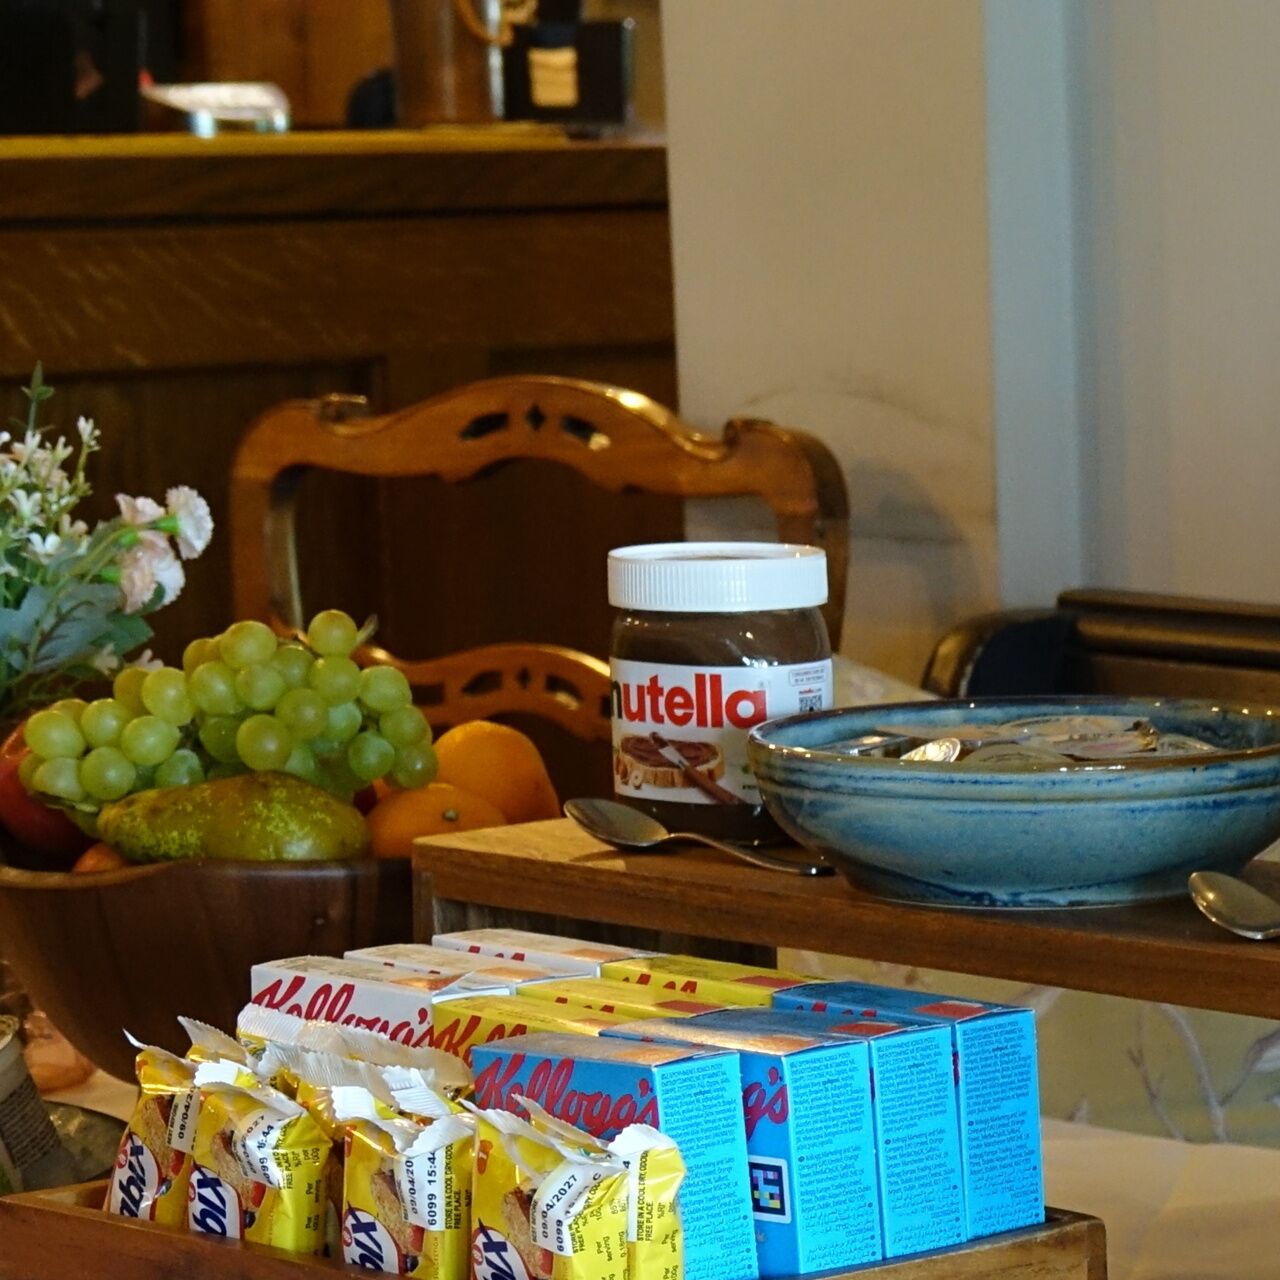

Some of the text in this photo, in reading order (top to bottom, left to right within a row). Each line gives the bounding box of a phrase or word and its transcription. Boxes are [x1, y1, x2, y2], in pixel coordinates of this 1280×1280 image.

[611, 672, 767, 729] nutella
[445, 1176, 453, 1193] COOL
[638, 1186, 646, 1205] COOL
[427, 1193, 437, 1226] 6099
[541, 1174, 579, 1239] 09/04/2027
[445, 1208, 453, 1229] STORE
[453, 1210, 461, 1230] FREE
[555, 1219, 564, 1252] 6099
[637, 1220, 645, 1242] STORE
[645, 1223, 653, 1242] FREE
[603, 1235, 613, 1262] serving
